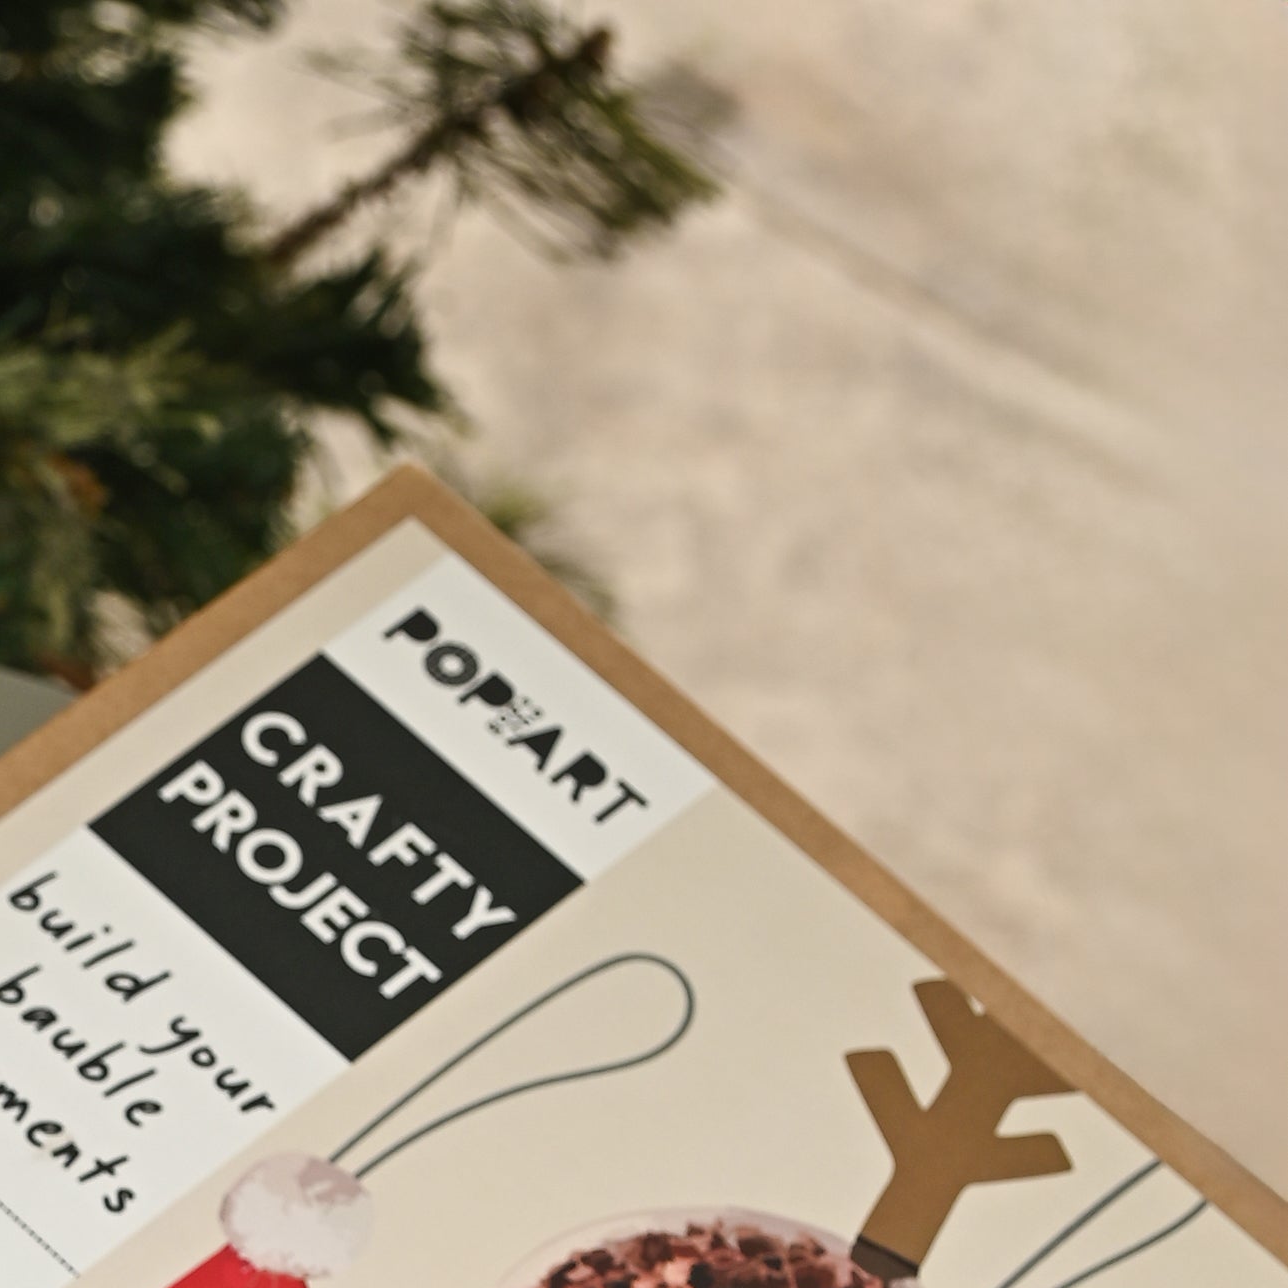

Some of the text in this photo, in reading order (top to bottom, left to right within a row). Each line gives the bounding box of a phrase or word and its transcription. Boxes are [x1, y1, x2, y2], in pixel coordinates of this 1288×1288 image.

[242, 712, 514, 937] CRAFTY
[383, 606, 648, 822] POP ART
[6, 870, 276, 1114] build your
[160, 758, 440, 997] PROJECT
